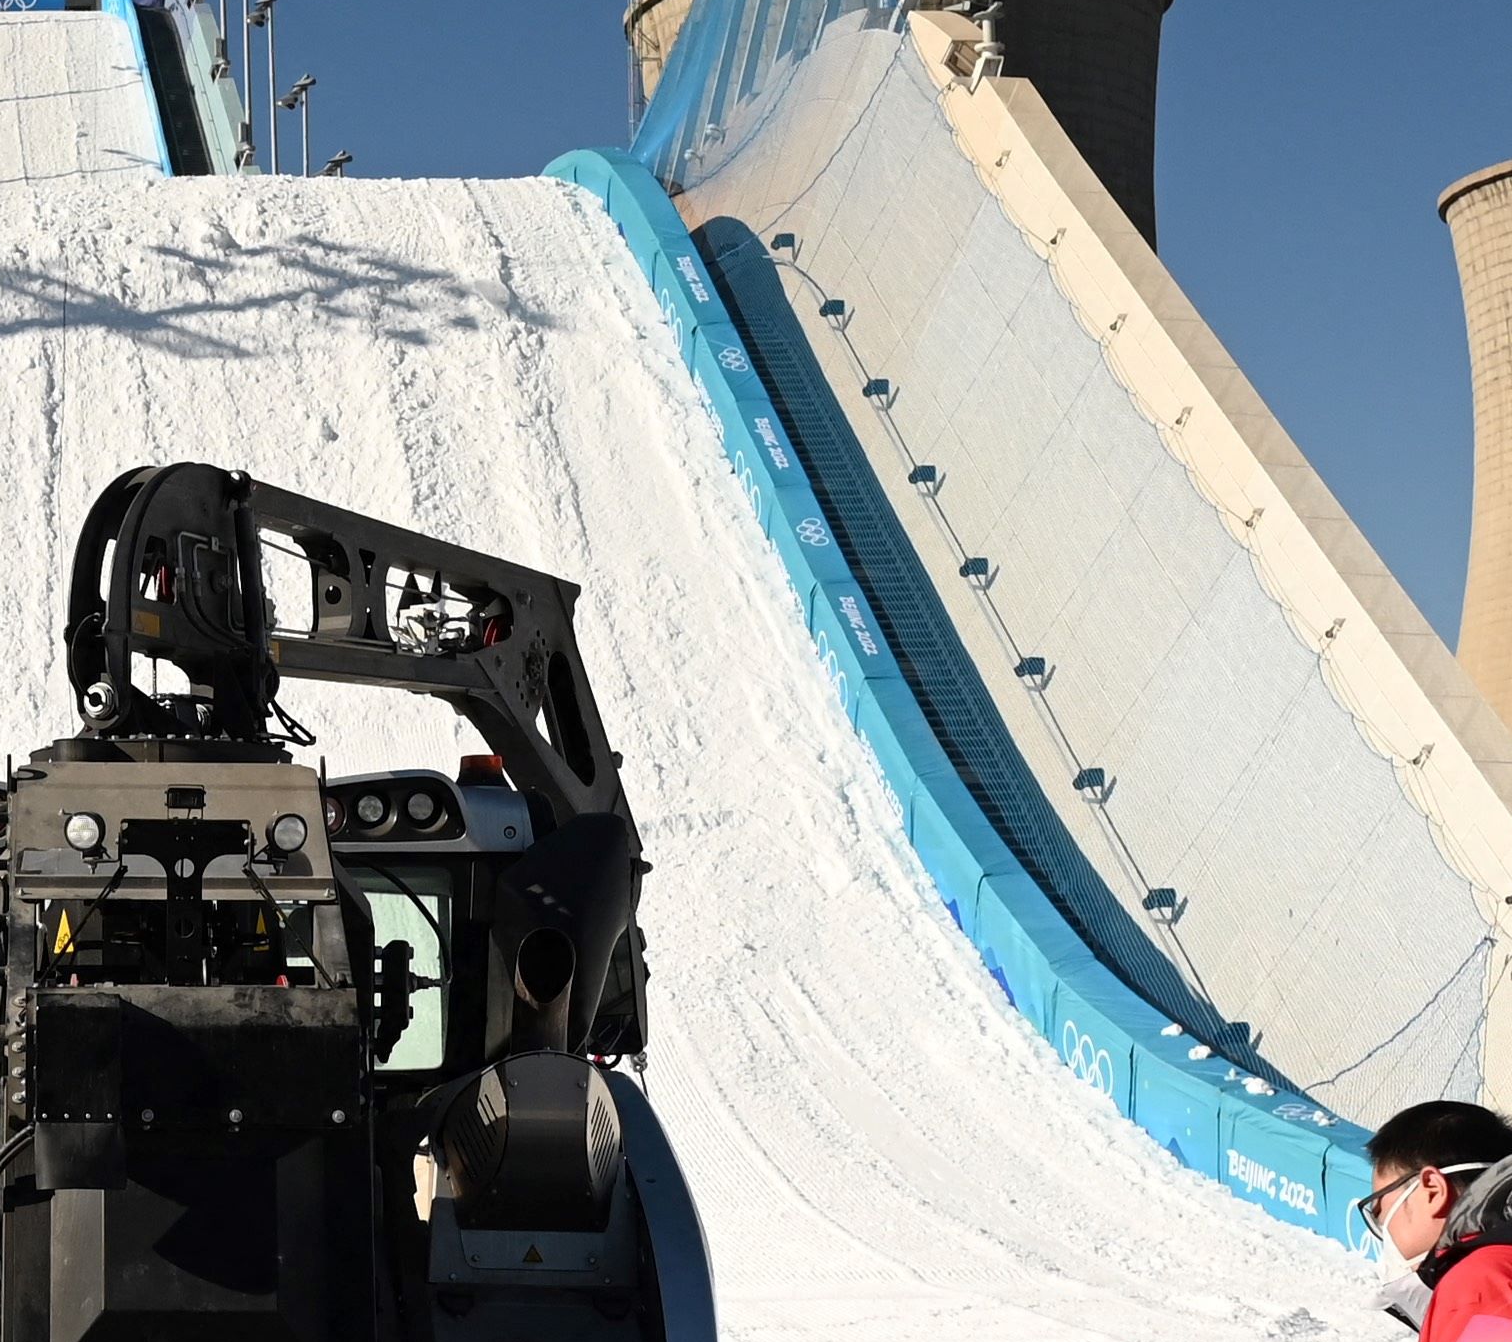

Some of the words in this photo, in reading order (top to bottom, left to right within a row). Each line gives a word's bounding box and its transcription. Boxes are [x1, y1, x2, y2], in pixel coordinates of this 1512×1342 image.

[838, 595, 866, 629] BEIJING
[854, 630, 878, 656] 2022
[1226, 1149, 1276, 1200] BEIJING
[1279, 1176, 1318, 1215] 2022
